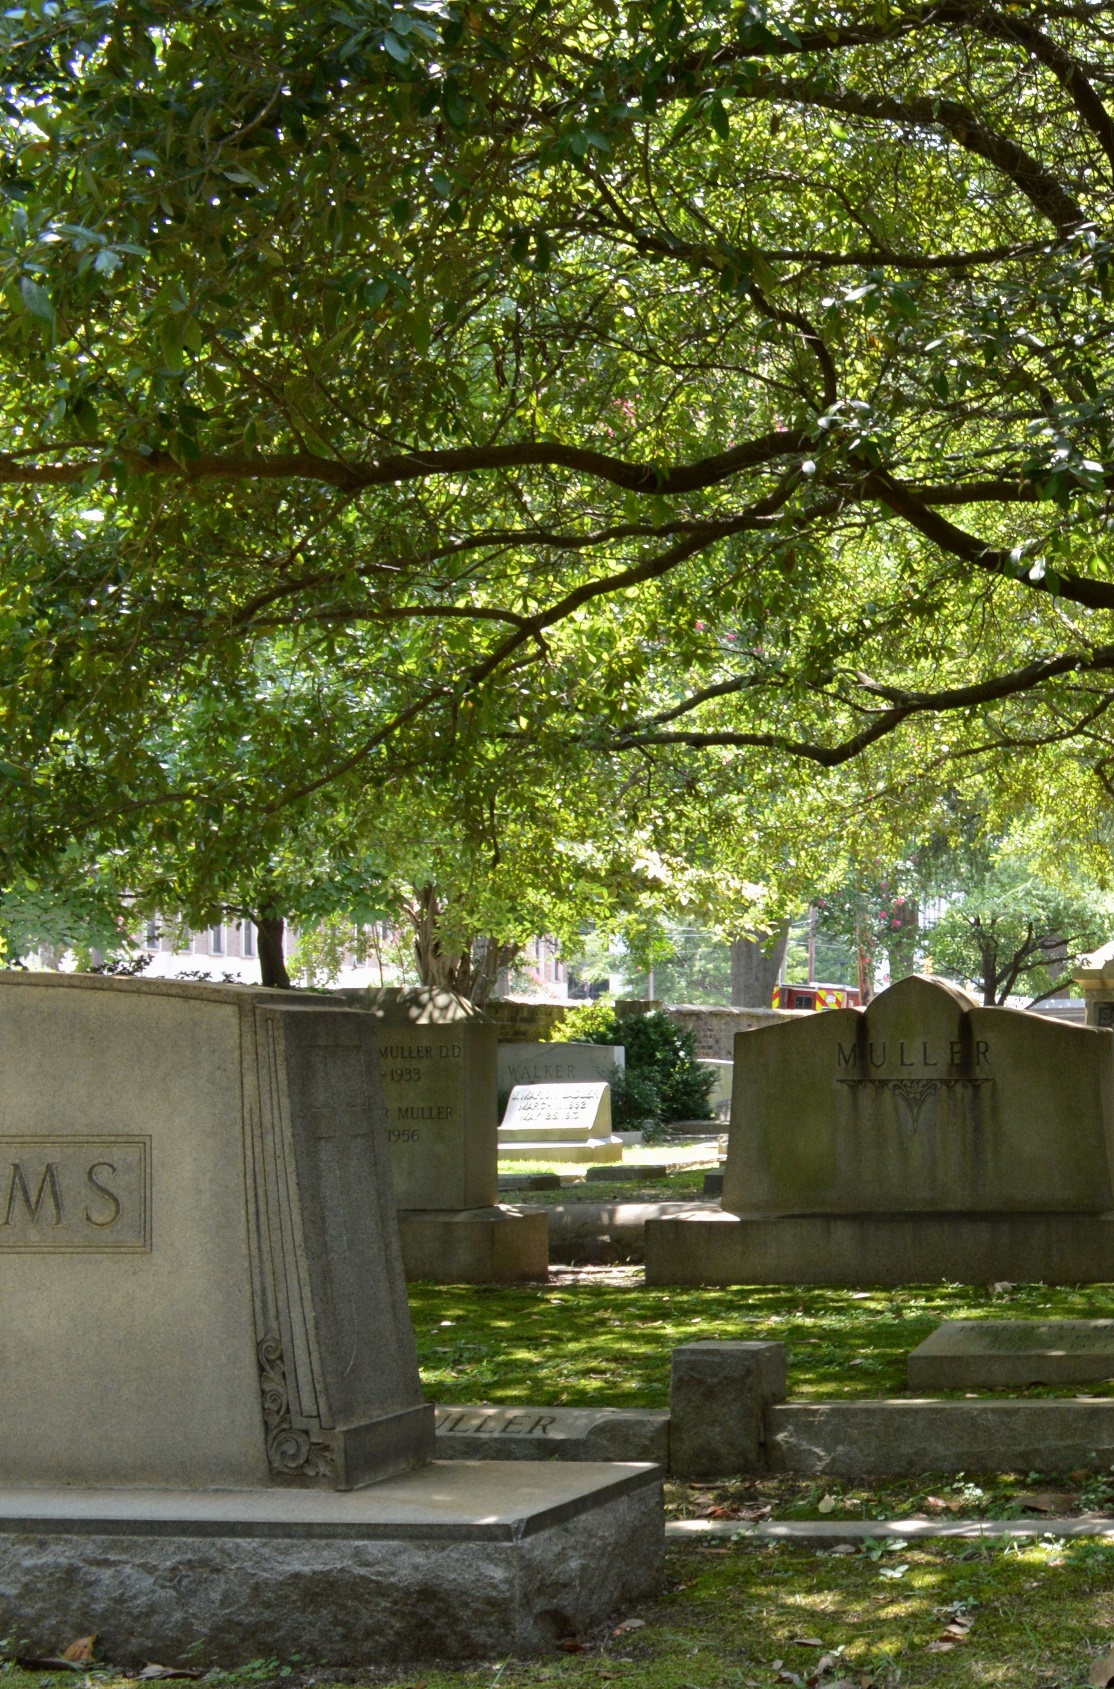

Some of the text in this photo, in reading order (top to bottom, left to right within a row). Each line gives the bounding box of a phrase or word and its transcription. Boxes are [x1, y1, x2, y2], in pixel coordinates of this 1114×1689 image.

[379, 1045, 433, 1059] MULLER
[837, 1041, 992, 1067] MULLER
[507, 1064, 575, 1079] WALKER
[397, 1105, 454, 1121] MULLER
[387, 1128, 420, 1143] 1956
[1, 1161, 121, 1227] MS
